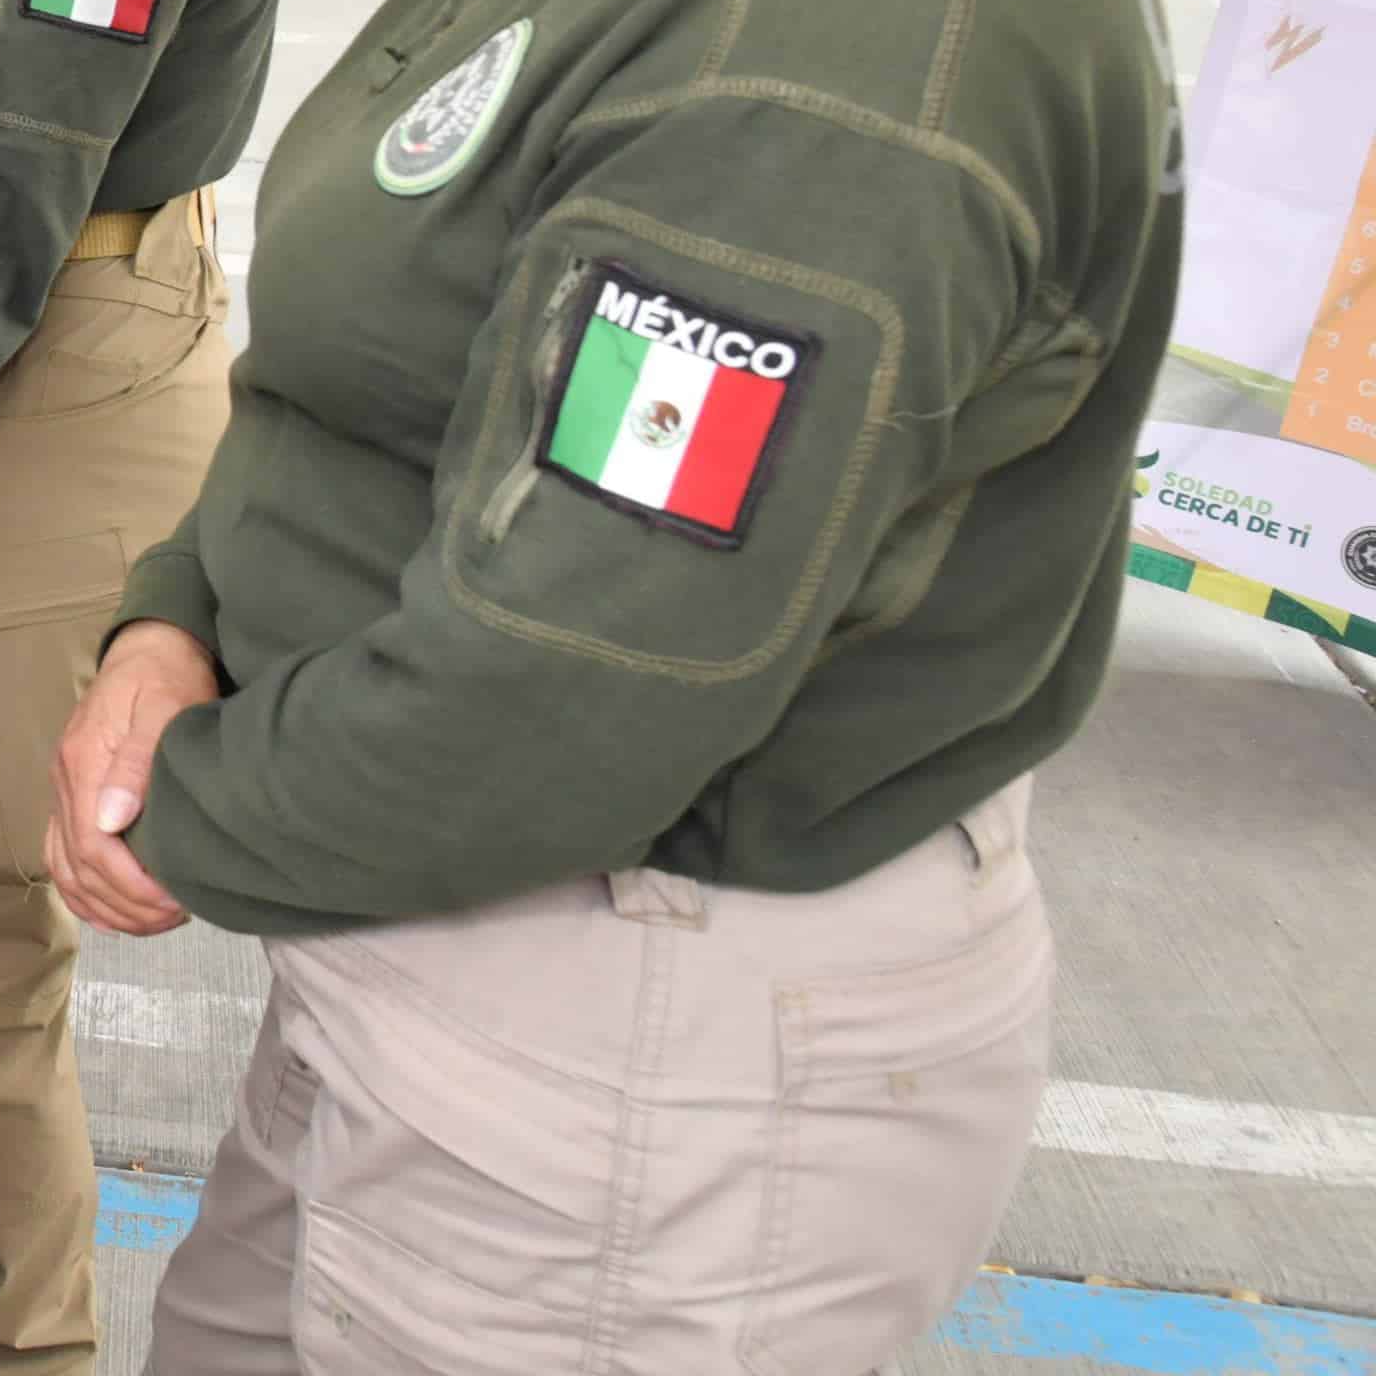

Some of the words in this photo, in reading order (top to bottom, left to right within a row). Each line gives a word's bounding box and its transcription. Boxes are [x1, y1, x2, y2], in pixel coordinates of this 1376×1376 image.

[594, 280, 798, 380] MÉXICO
[1158, 488, 1240, 528] CERCA
[1246, 514, 1281, 540] DE
[1162, 470, 1273, 516] SOLEDAD
